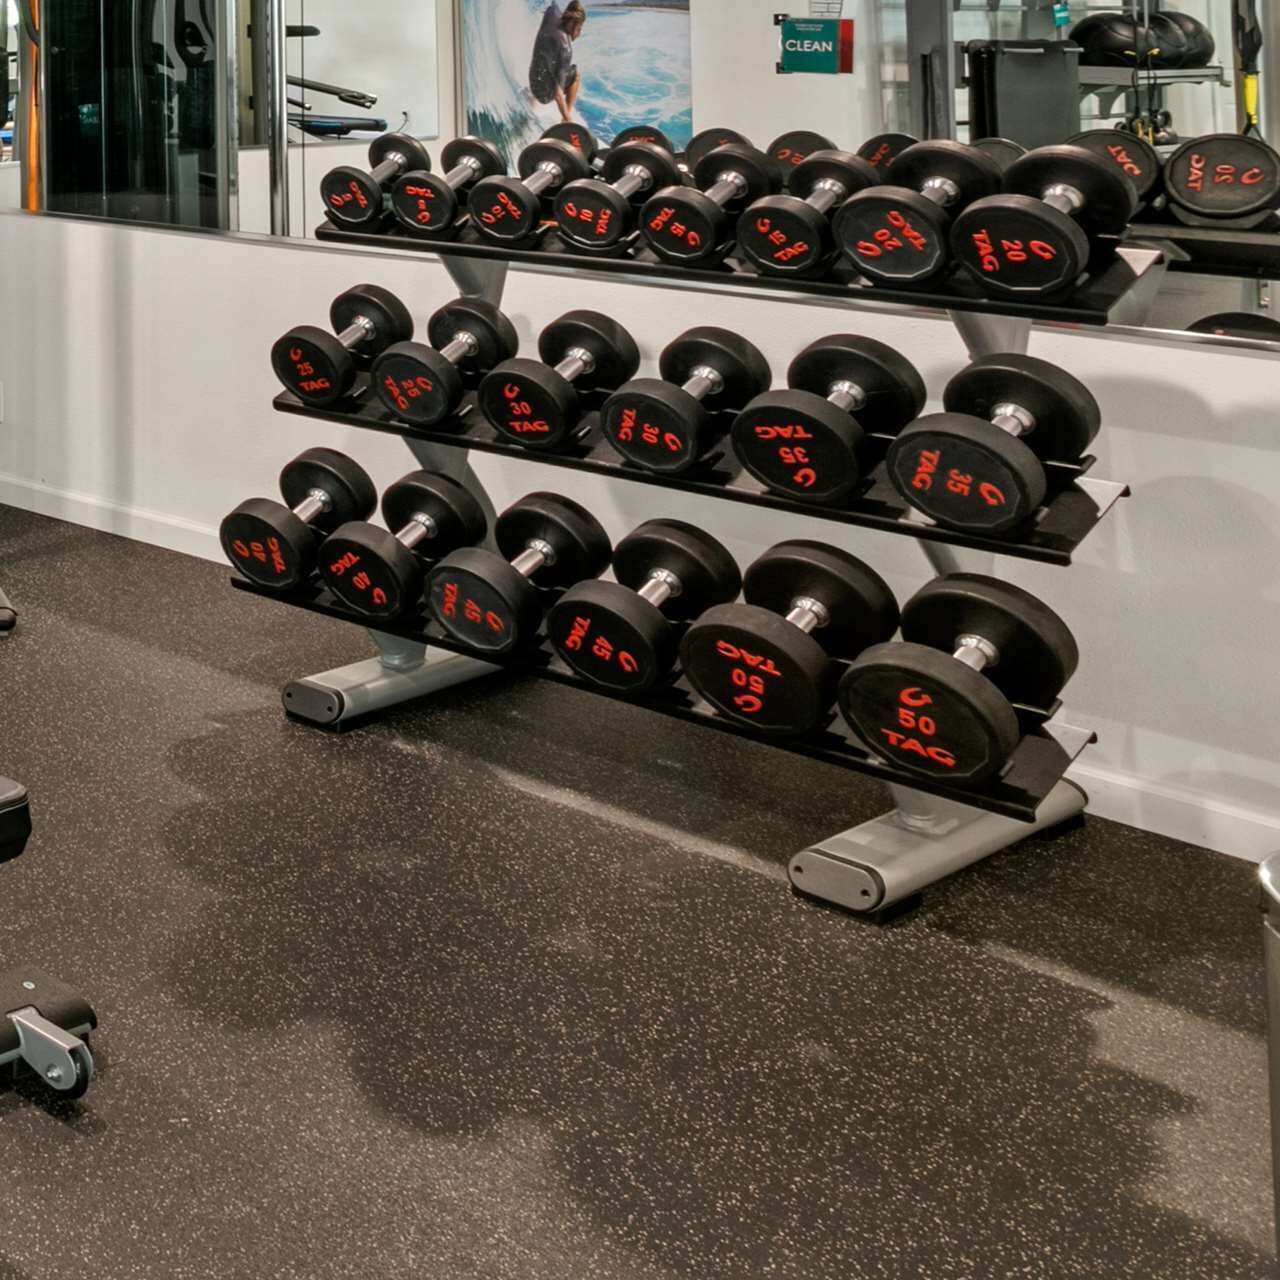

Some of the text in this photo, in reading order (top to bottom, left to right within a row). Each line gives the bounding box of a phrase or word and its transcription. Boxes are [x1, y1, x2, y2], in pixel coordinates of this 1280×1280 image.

[785, 39, 833, 52] CLEAN
[768, 229, 787, 246] 15
[873, 227, 903, 251] 20
[886, 210, 927, 252] TAG
[773, 241, 809, 261] TAG
[972, 228, 1000, 272] TAG
[1001, 239, 1028, 262] 20
[296, 362, 314, 376] 25
[299, 378, 330, 391] TAG
[384, 375, 409, 410] TAG
[401, 378, 422, 397] 25
[510, 401, 532, 416] 30
[510, 420, 549, 433] TAG
[617, 409, 637, 441] TAG
[641, 423, 660, 444] 30
[754, 424, 812, 440] TAG
[778, 446, 810, 465] 35
[911, 450, 941, 490] TAG
[945, 468, 973, 497] 35
[250, 541, 266, 562] 40
[330, 551, 359, 575] TAG
[352, 571, 371, 590] 40
[441, 582, 458, 616] TAG
[464, 599, 482, 623] 45
[565, 616, 591, 650] TAG
[592, 635, 613, 661] 45
[716, 639, 782, 677] TAG
[731, 667, 765, 696] 50
[897, 706, 937, 737] 50
[880, 728, 956, 768] TAG
